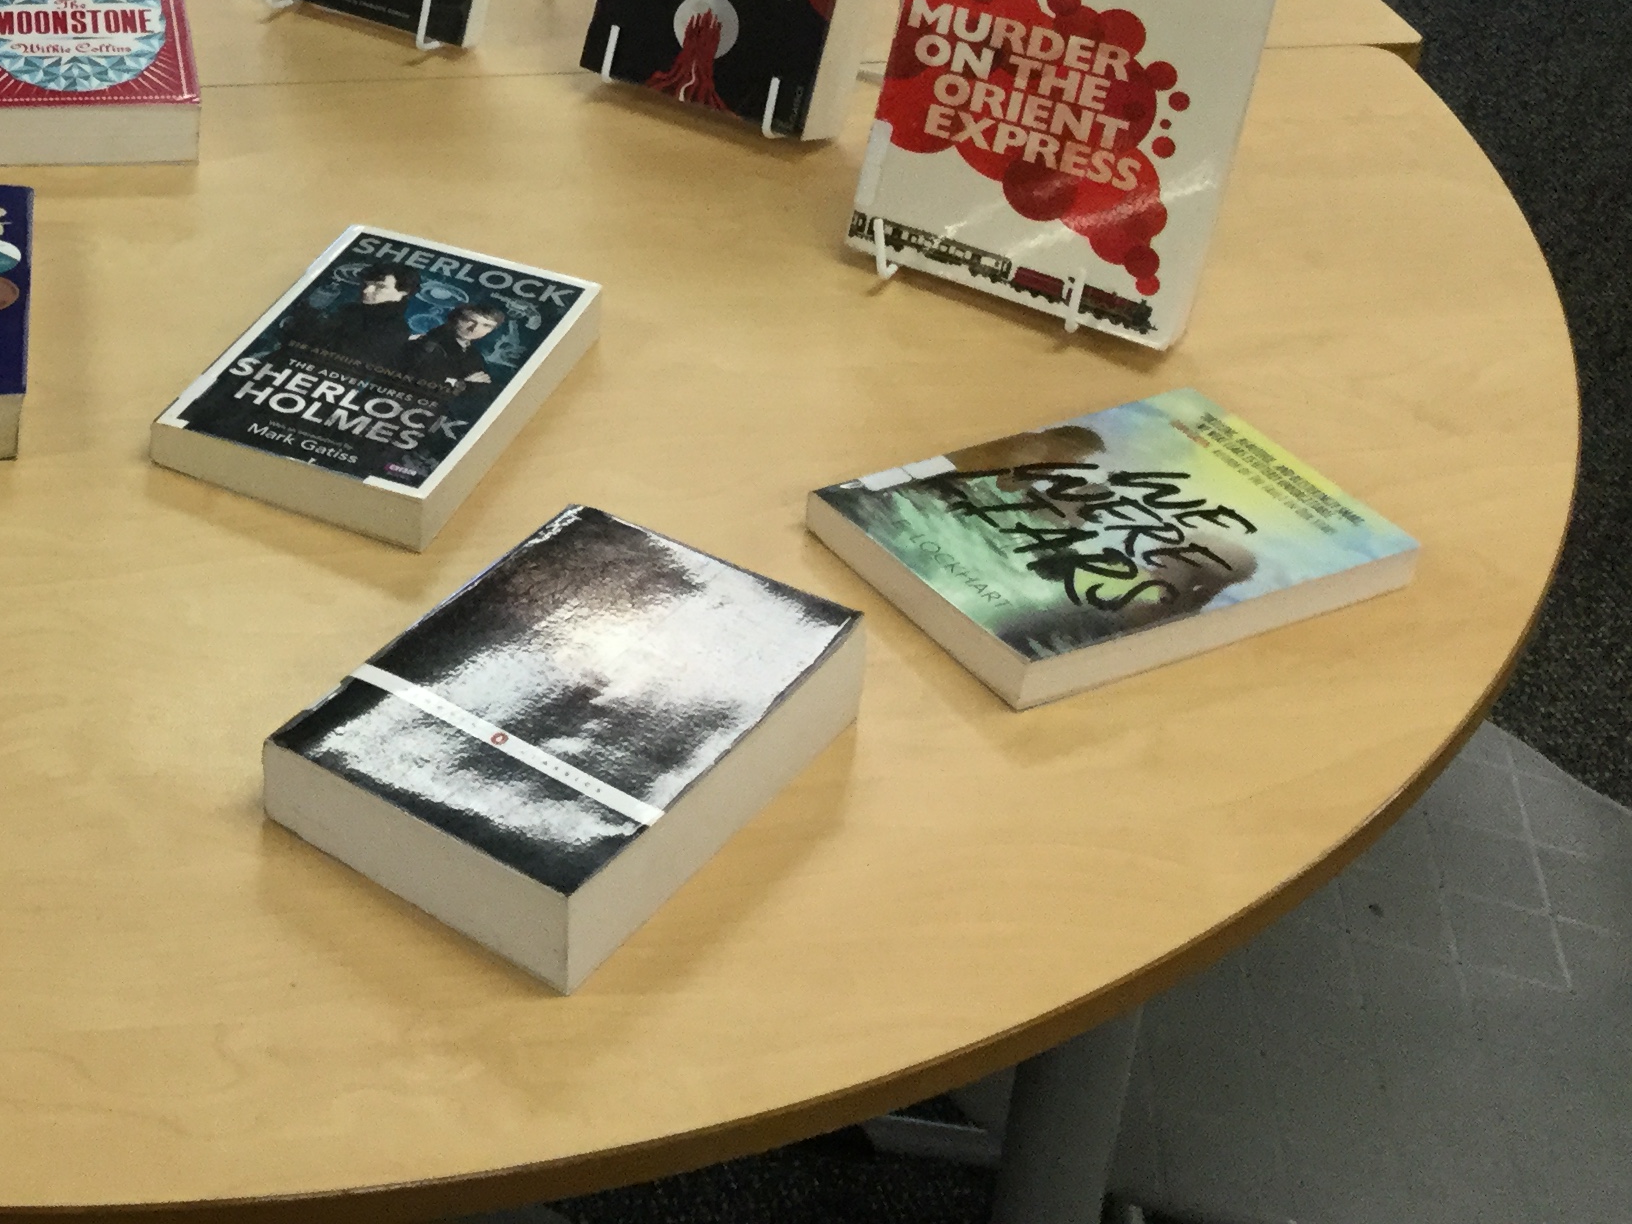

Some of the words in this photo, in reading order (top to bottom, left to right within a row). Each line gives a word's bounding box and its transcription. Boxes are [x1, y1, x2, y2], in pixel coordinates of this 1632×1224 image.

[11, 43, 71, 54] Wilkie
[75, 41, 132, 53] Collins
[914, 32, 995, 80] ON
[1008, 51, 1111, 113] THE
[923, 102, 1143, 192] EXPRESS
[933, 74, 1130, 152] ORIENT
[352, 236, 577, 308] SHERLOCK
[228, 357, 468, 440] SHERLOCK
[289, 359, 314, 372] THE
[318, 369, 413, 403] ADVENTURES
[417, 397, 439, 408] OF
[310, 344, 362, 367] ARTHUR
[365, 361, 412, 383] CONAN
[416, 377, 464, 396] DOYLE
[233, 380, 425, 450] HOLMES
[247, 423, 295, 445] Mark
[301, 438, 358, 465] Gatiss
[1108, 470, 1258, 535] WE
[909, 532, 1014, 611] LOCKHART
